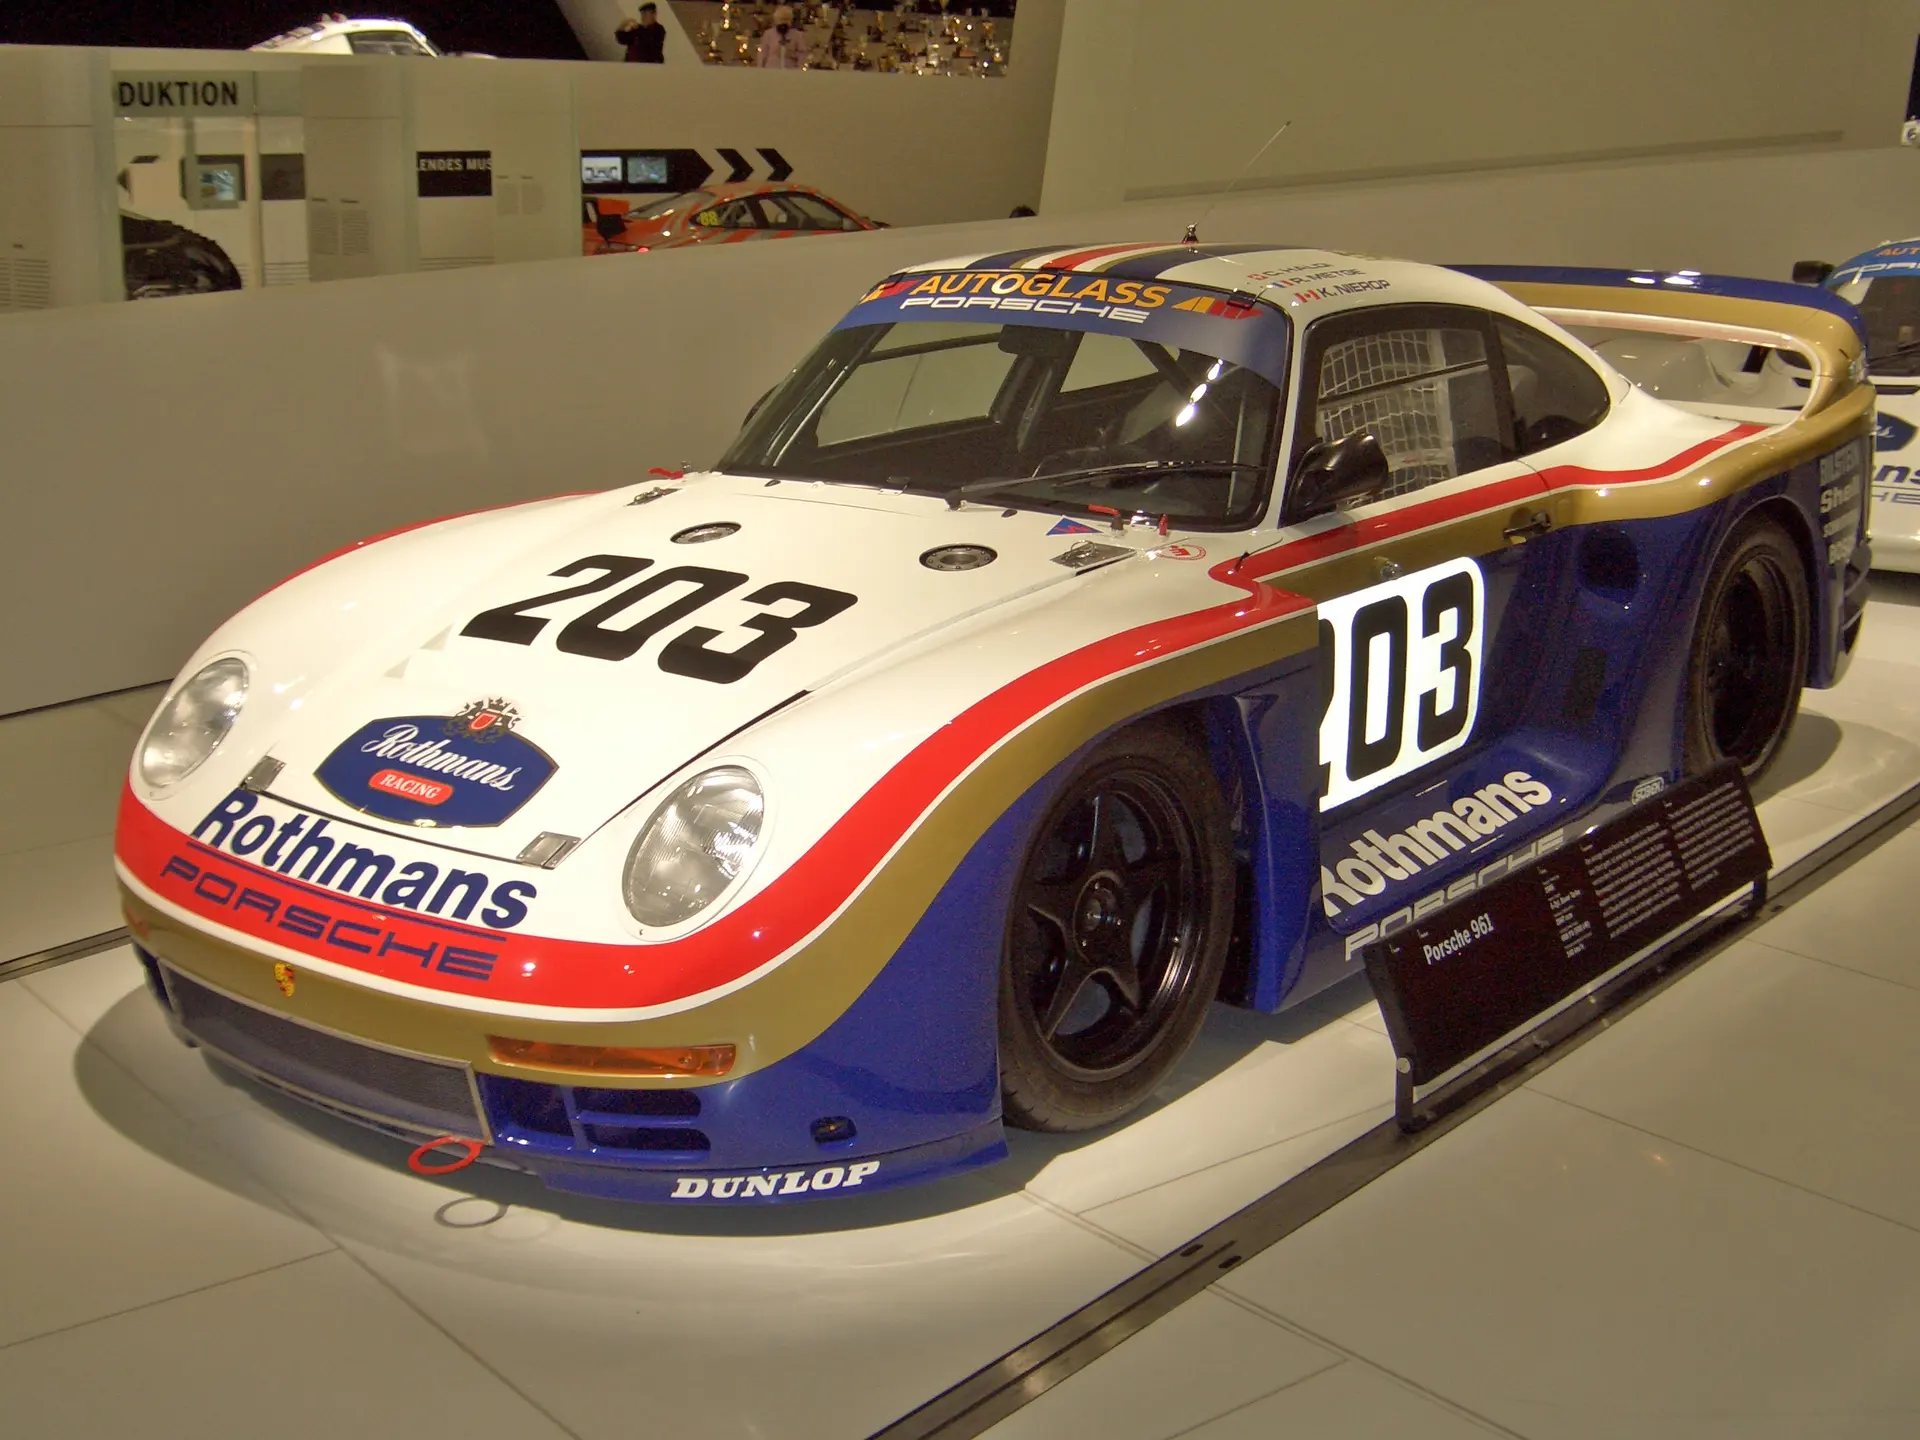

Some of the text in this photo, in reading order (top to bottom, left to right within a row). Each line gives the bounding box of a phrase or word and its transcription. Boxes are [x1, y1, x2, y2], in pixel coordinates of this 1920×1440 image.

[118, 81, 238, 107] DUKTION
[899, 296, 1151, 325] PORSCHE
[910, 272, 1173, 309] AUTOGLASS
[459, 554, 859, 685] 203
[361, 724, 523, 791] Rothmans
[379, 773, 441, 800] RACING
[191, 787, 537, 929] Rothmans
[159, 854, 500, 981] PORSCHE
[1423, 913, 1494, 966] Porsche 961
[670, 1160, 881, 1199] DUNLOP
